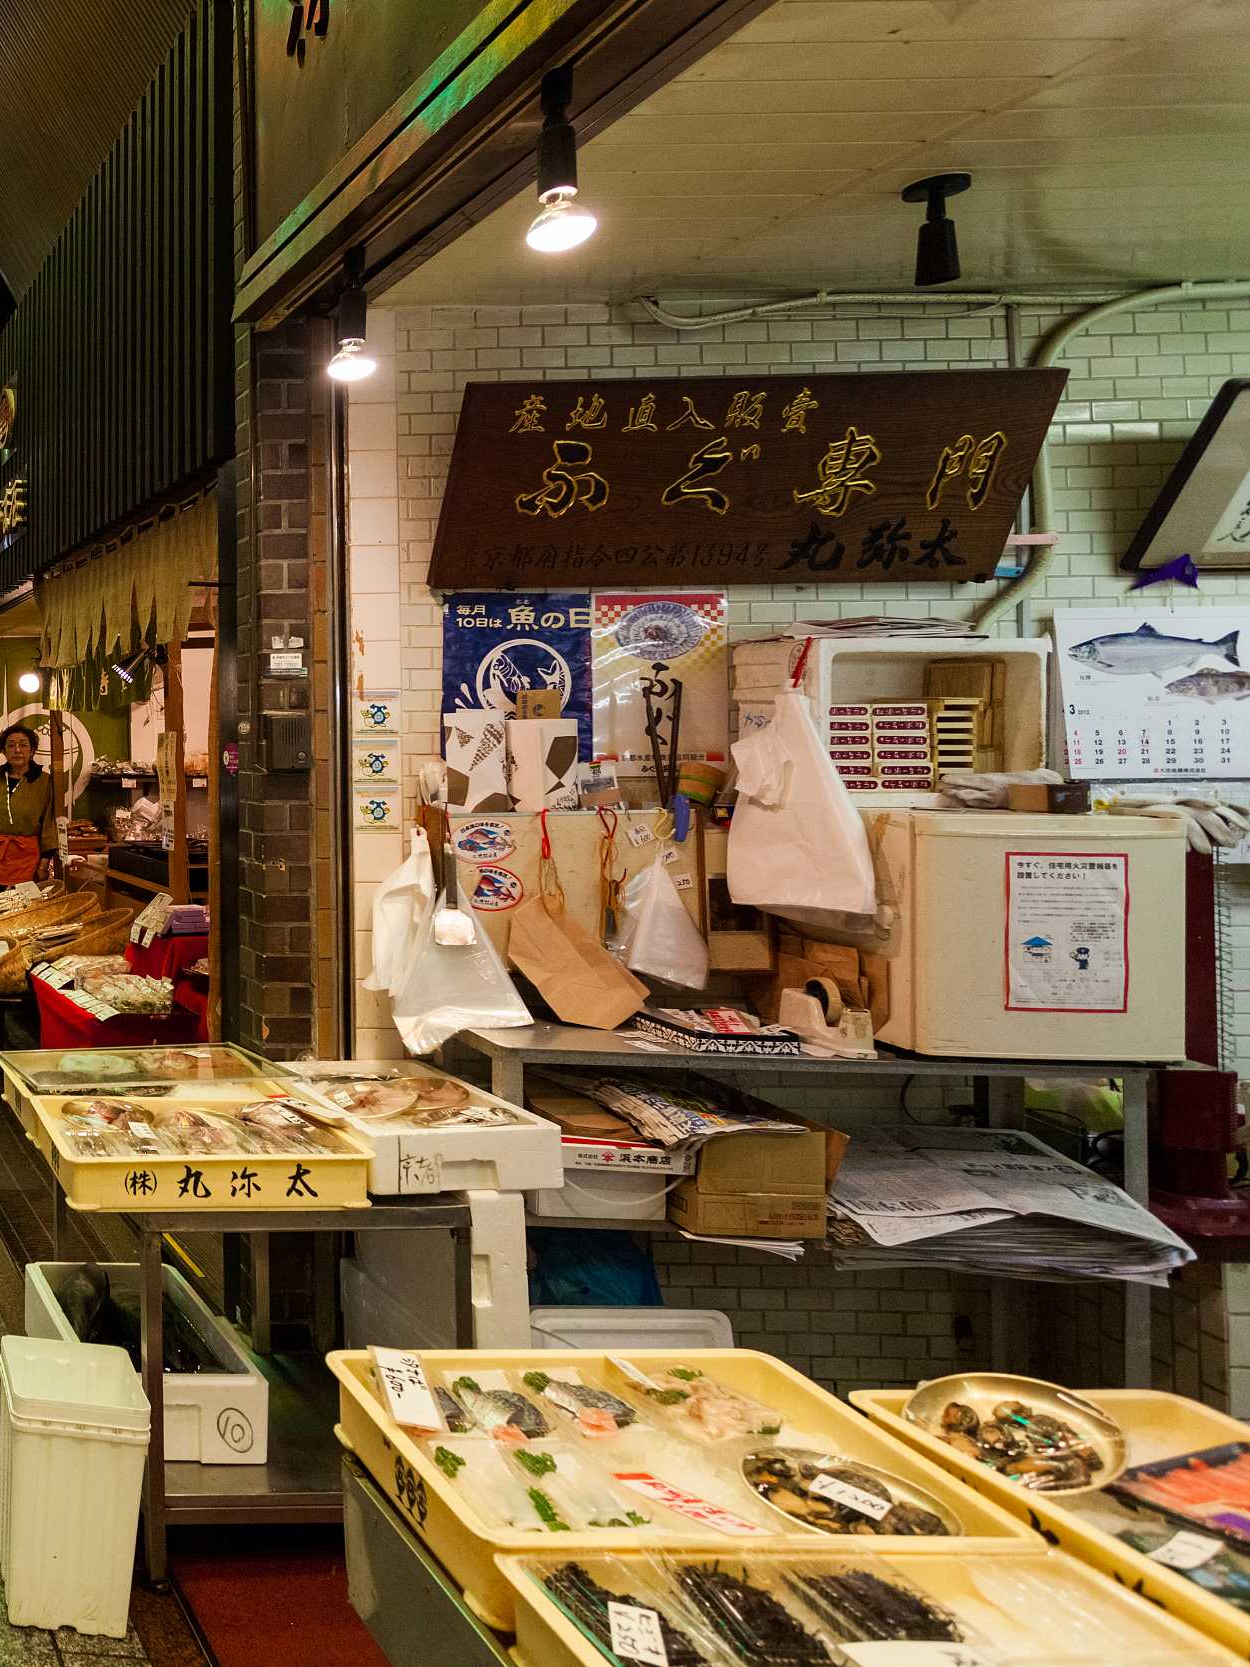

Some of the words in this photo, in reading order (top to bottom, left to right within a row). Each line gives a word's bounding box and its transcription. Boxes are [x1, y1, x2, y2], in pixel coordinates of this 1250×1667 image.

[456, 604, 486, 616] 毎月
[456, 617, 503, 628] 10日は
[506, 605, 591, 631] 魚の日
[1069, 705, 1075, 715] 3
[1017, 861, 1118, 870] 今すぐ、住宅用火災警報器を
[619, 1153, 672, 1166] 浜本商店
